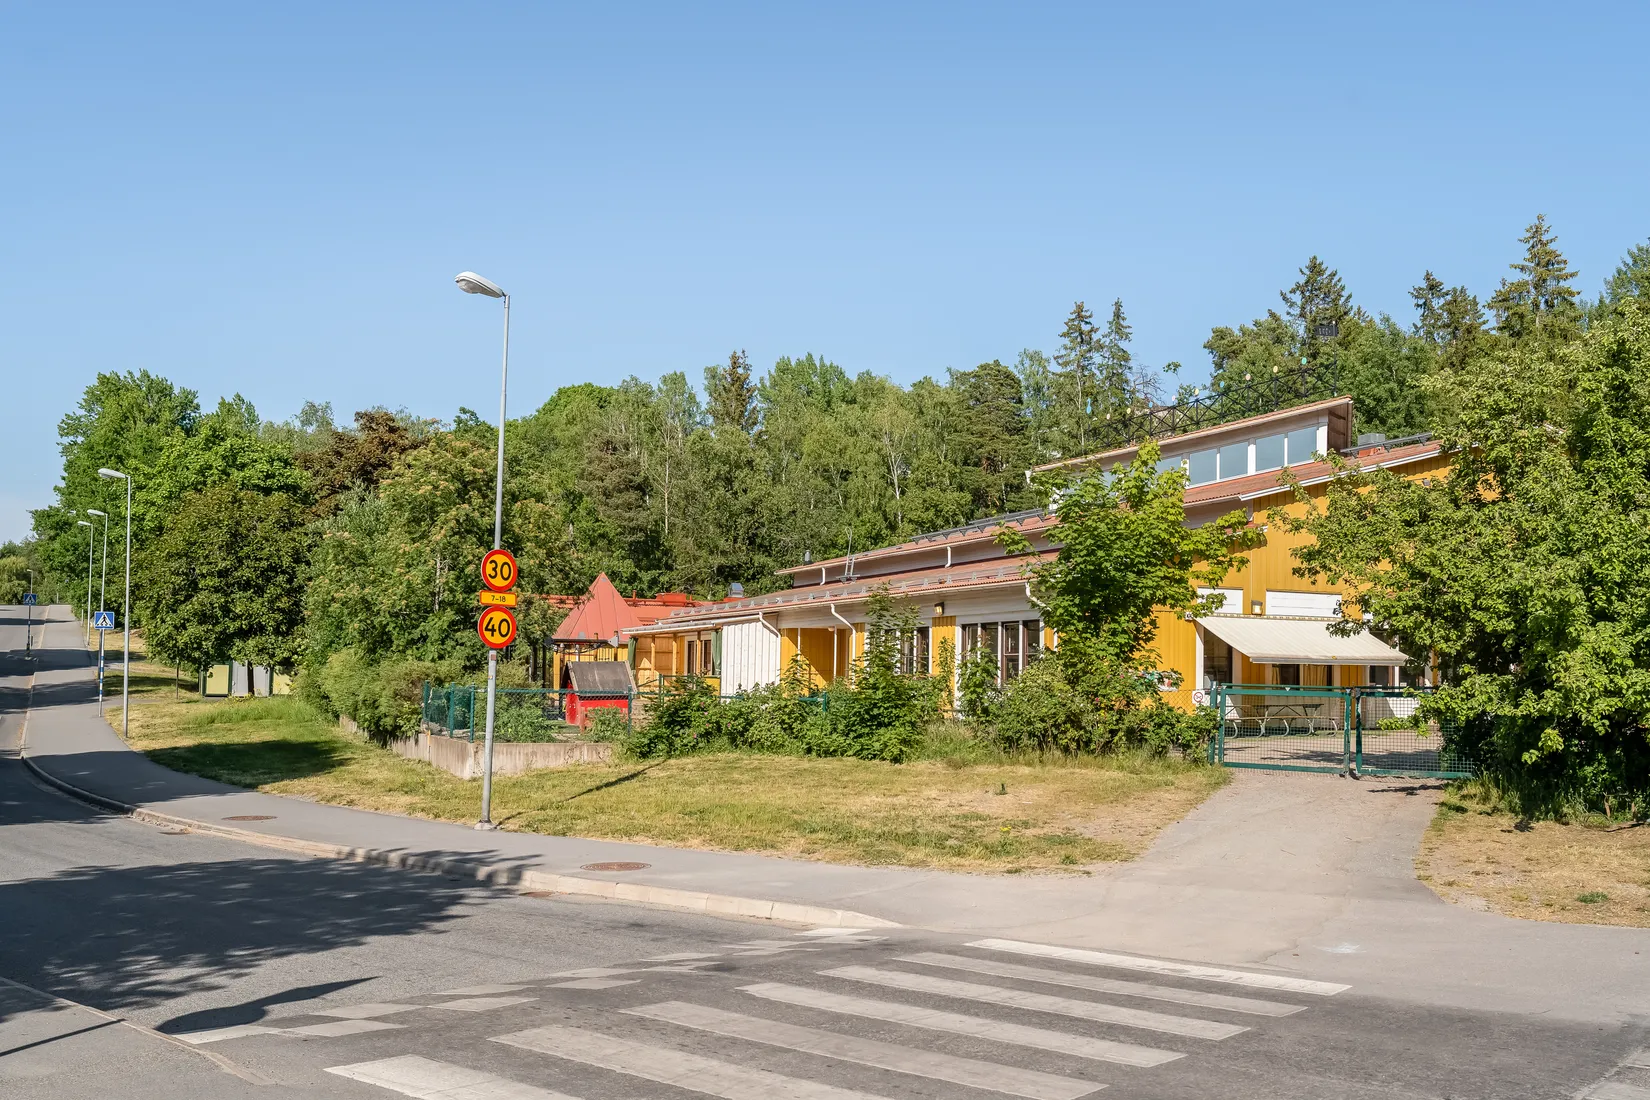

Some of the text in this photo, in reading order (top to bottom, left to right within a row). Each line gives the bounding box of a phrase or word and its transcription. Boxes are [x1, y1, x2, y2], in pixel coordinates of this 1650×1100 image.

[488, 560, 512, 581] 30
[491, 595, 506, 603] 7-18
[484, 617, 511, 638] 40
